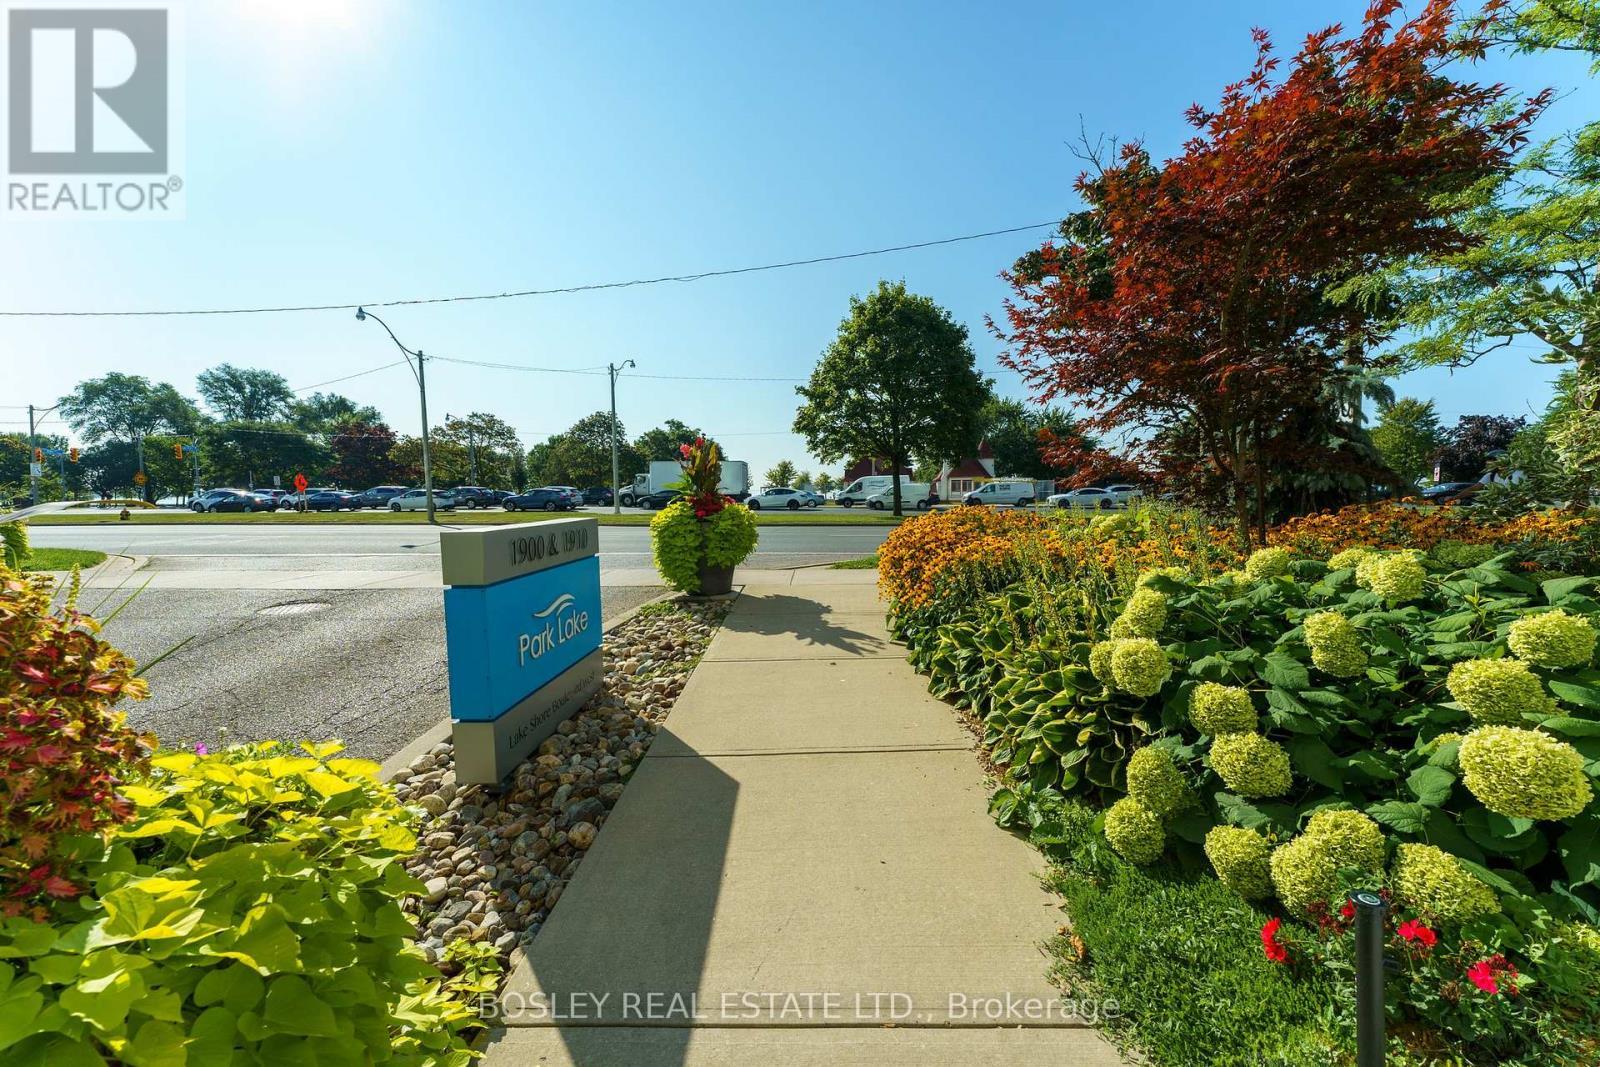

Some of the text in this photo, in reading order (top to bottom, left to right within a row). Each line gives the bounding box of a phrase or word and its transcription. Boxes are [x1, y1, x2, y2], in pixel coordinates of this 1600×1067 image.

[511, 528, 588, 566] 1900 & 1910
[519, 609, 589, 666] Park Lake
[509, 725, 529, 749] Lake
[529, 707, 552, 728] Shore
